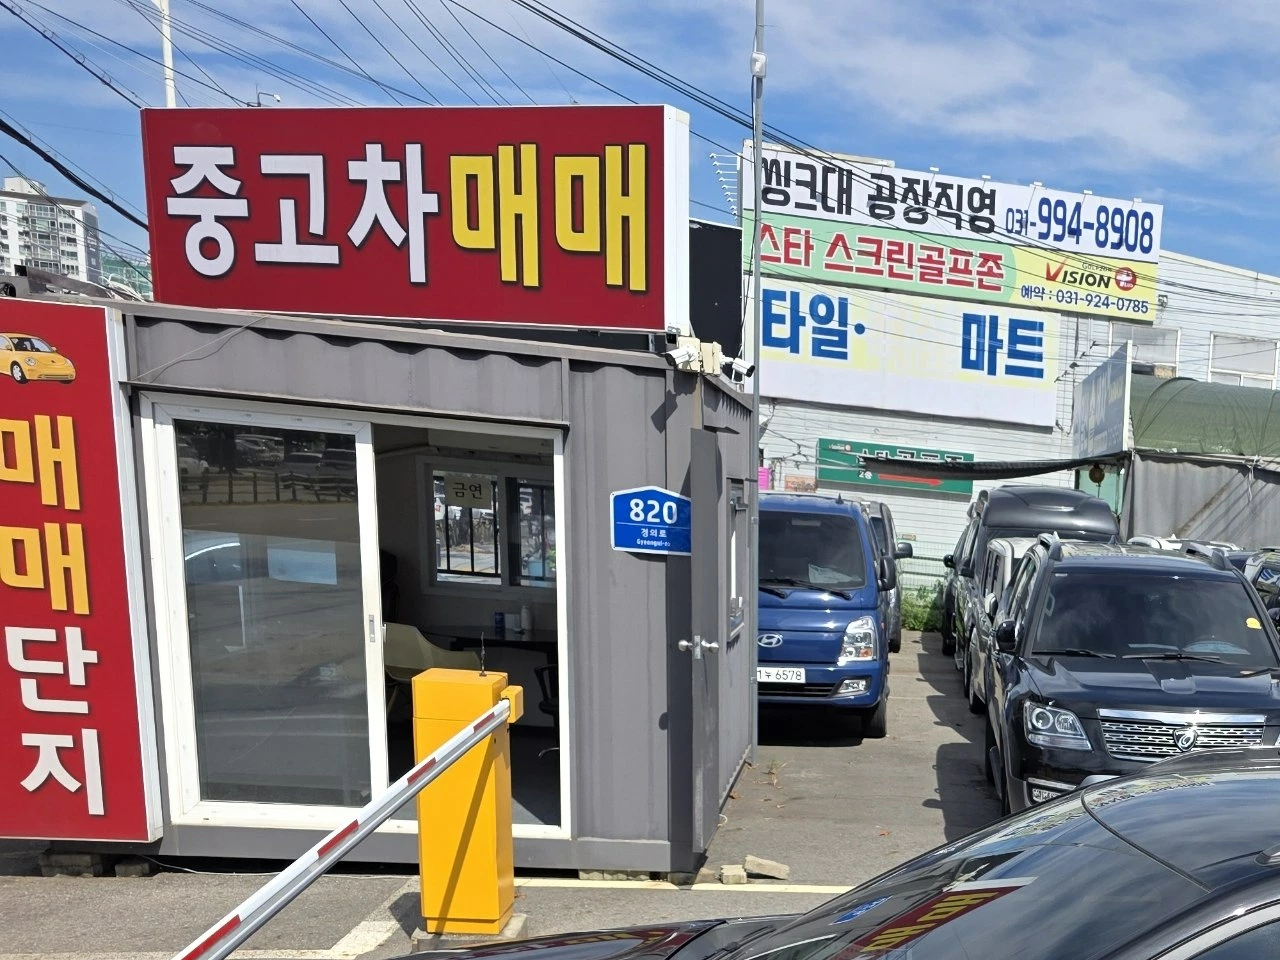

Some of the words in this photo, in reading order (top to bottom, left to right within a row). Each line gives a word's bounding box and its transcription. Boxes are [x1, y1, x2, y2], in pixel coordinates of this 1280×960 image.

[166, 142, 648, 292] 중고차매매
[761, 156, 852, 216] 씽크대
[867, 172, 997, 234] 공장직영
[1005, 196, 1154, 254] 031-994-8908
[760, 223, 815, 268] 스타
[824, 232, 1005, 293] 스크린골프존
[1045, 257, 1112, 289] VISION
[1020, 284, 1046, 301] 예약
[1056, 289, 1149, 314] 031-924-0785
[961, 312, 1045, 379] 마트
[452, 481, 484, 500] 금연
[629, 498, 678, 525] 820
[640, 527, 668, 538] 경의로
[775, 669, 802, 681] 6578
